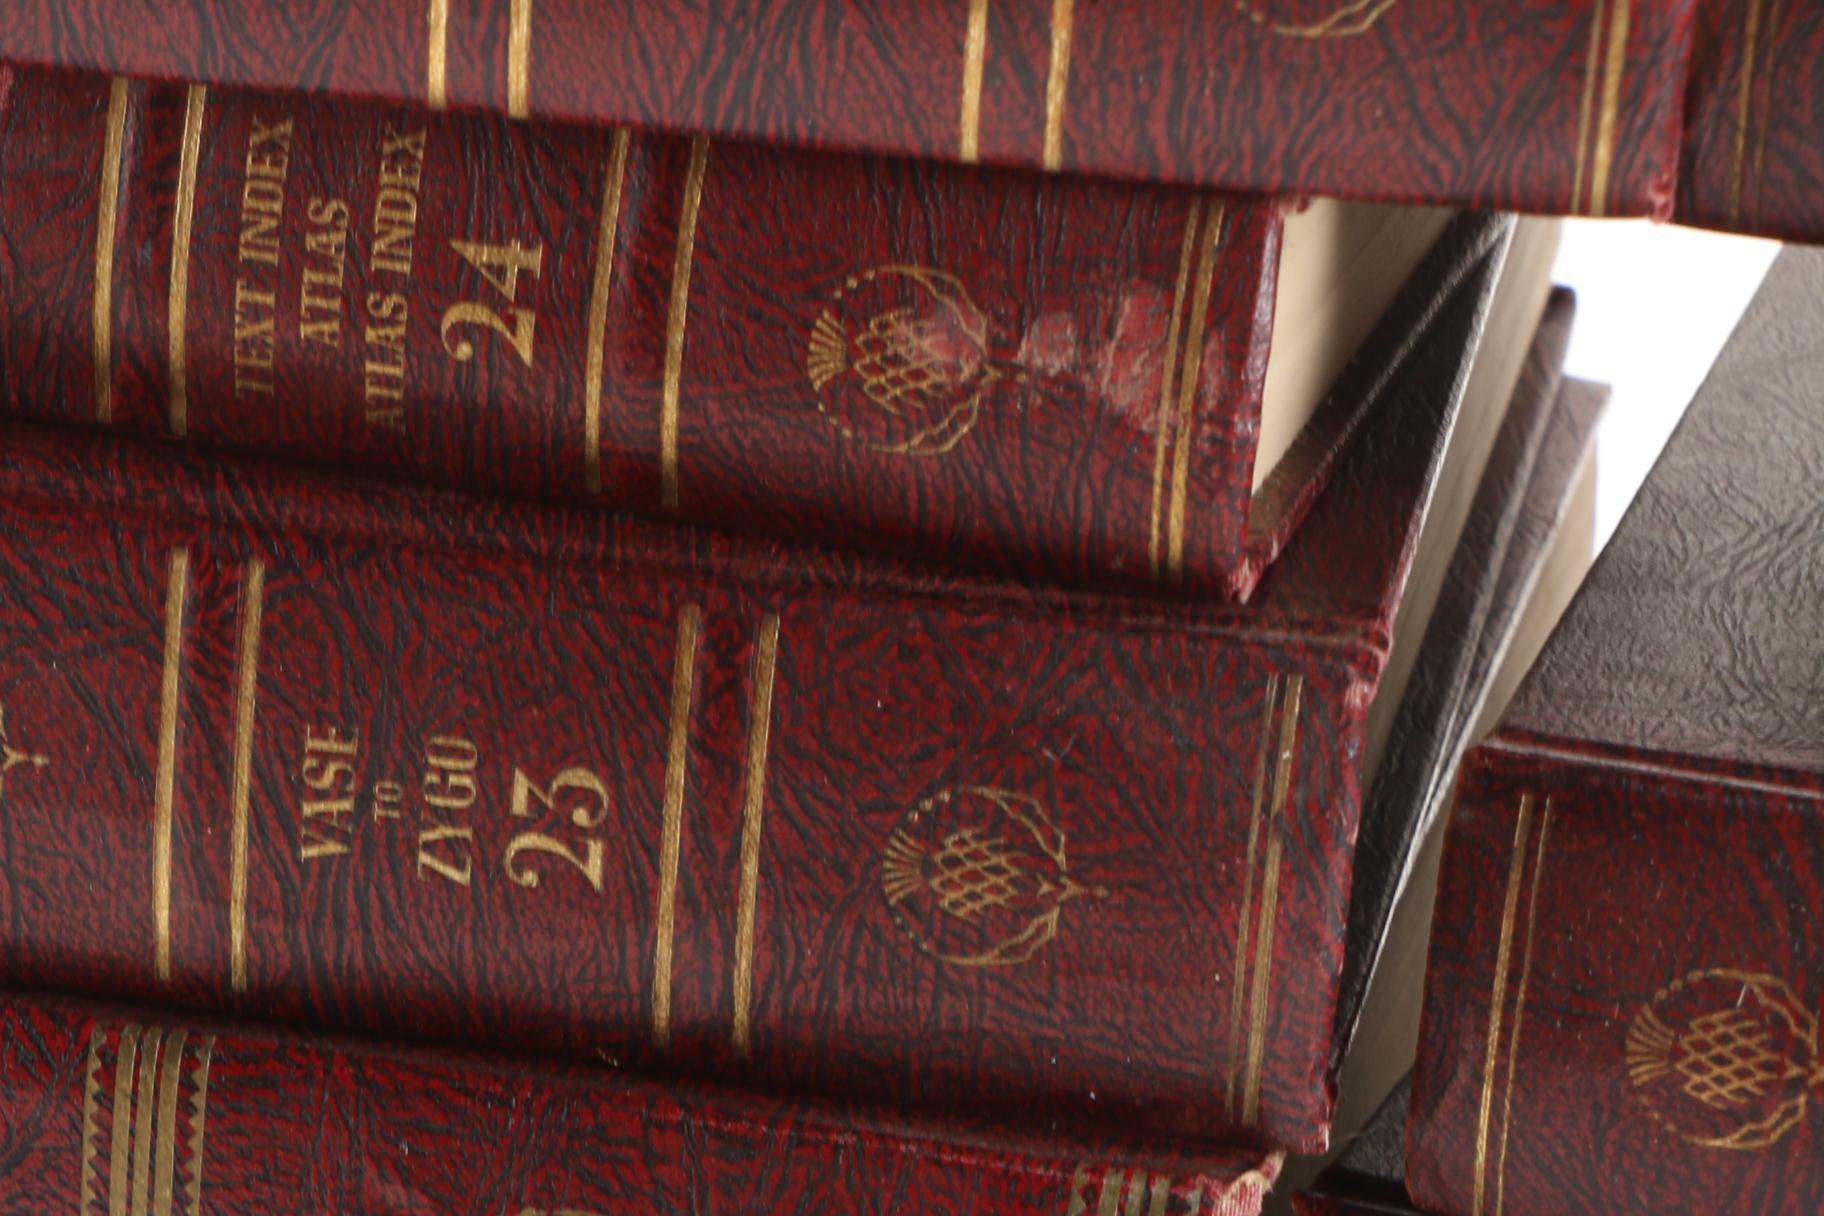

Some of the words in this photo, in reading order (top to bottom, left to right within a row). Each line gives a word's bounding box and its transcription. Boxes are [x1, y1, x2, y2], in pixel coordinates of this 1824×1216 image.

[239, 114, 294, 267] INDEX
[371, 122, 427, 275] INDEX
[234, 277, 277, 398] TEXT
[300, 197, 349, 349] ATLAS
[440, 238, 543, 369] 24
[364, 290, 408, 434] ATLAS
[300, 724, 359, 864] VASE
[373, 780, 403, 823] TO
[417, 735, 478, 887] ZYGO
[504, 767, 609, 894] 23
